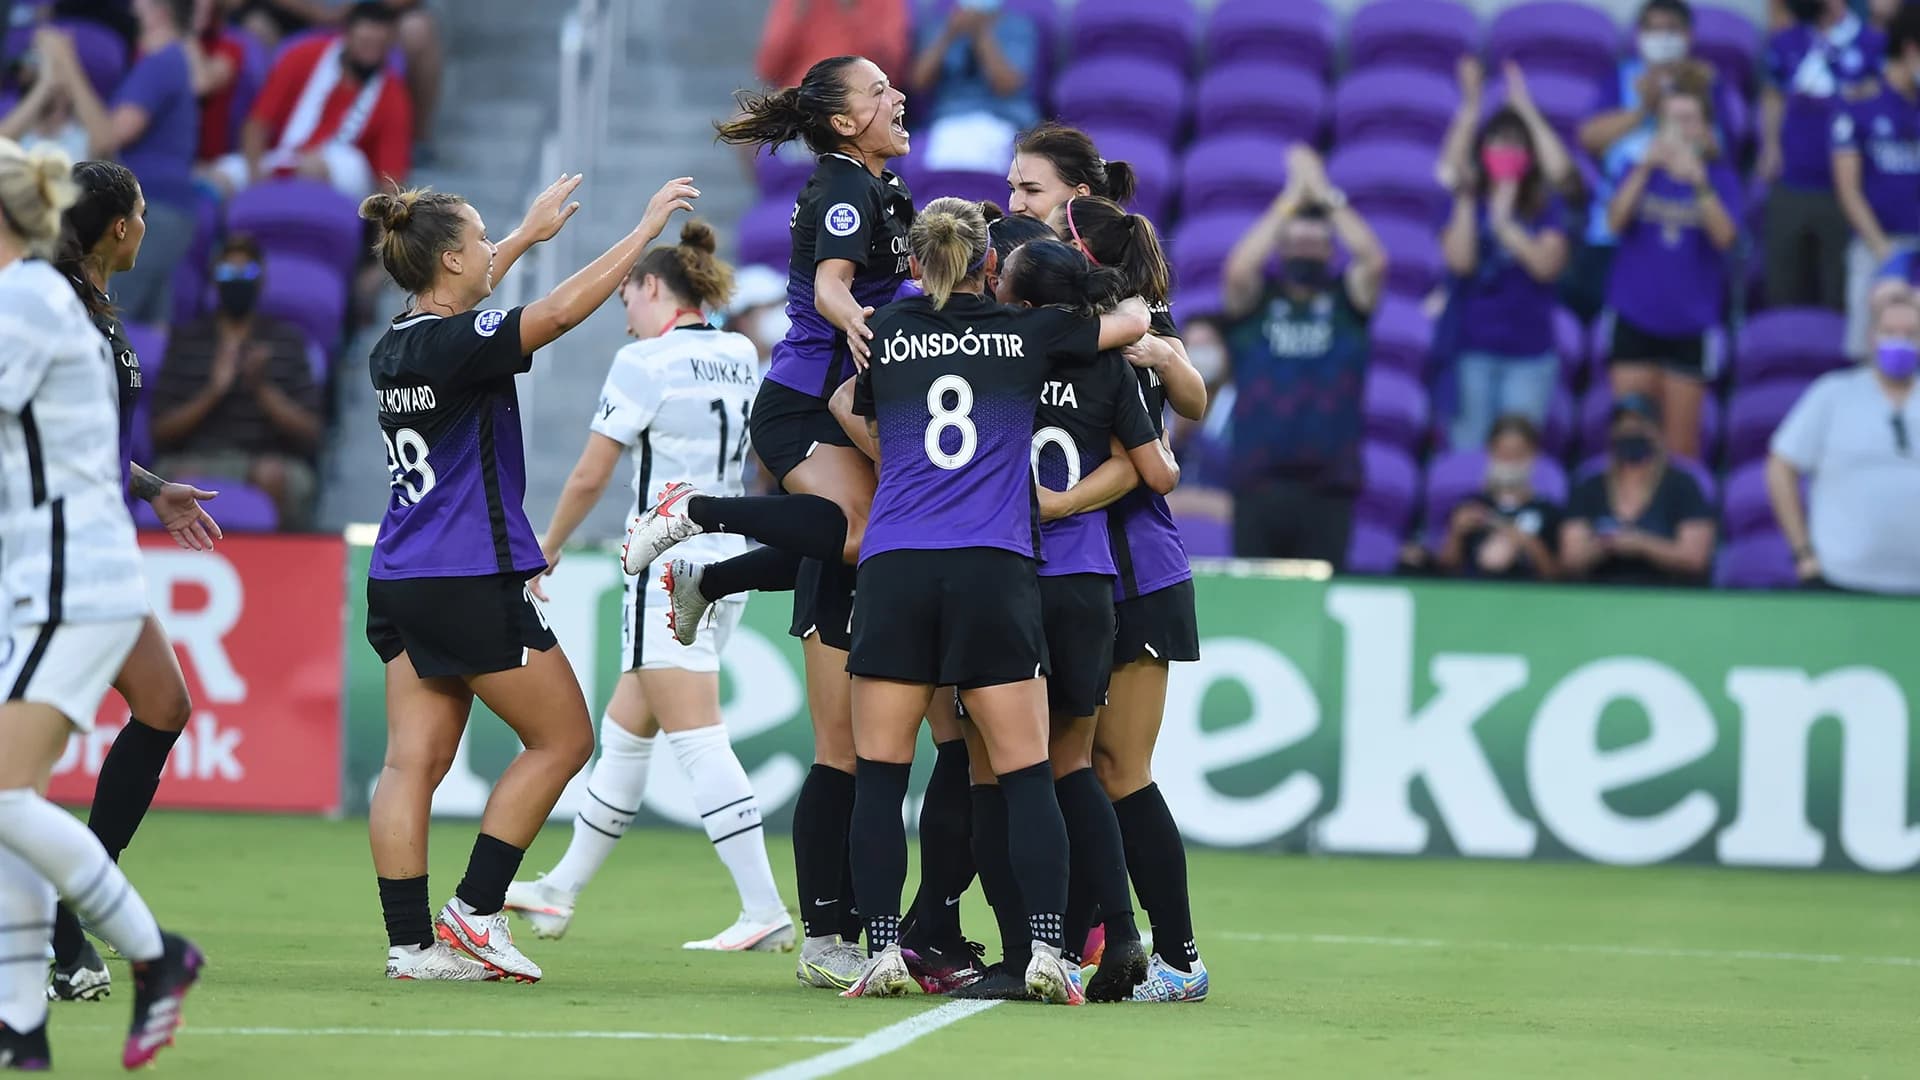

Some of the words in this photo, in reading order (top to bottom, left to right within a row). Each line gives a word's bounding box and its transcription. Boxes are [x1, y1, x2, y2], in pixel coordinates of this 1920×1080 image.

[880, 326, 1025, 365] JÓNSDÓTTIR
[690, 358, 757, 386] KUIKKA
[386, 385, 436, 413] HOWARD
[924, 374, 978, 471] 8
